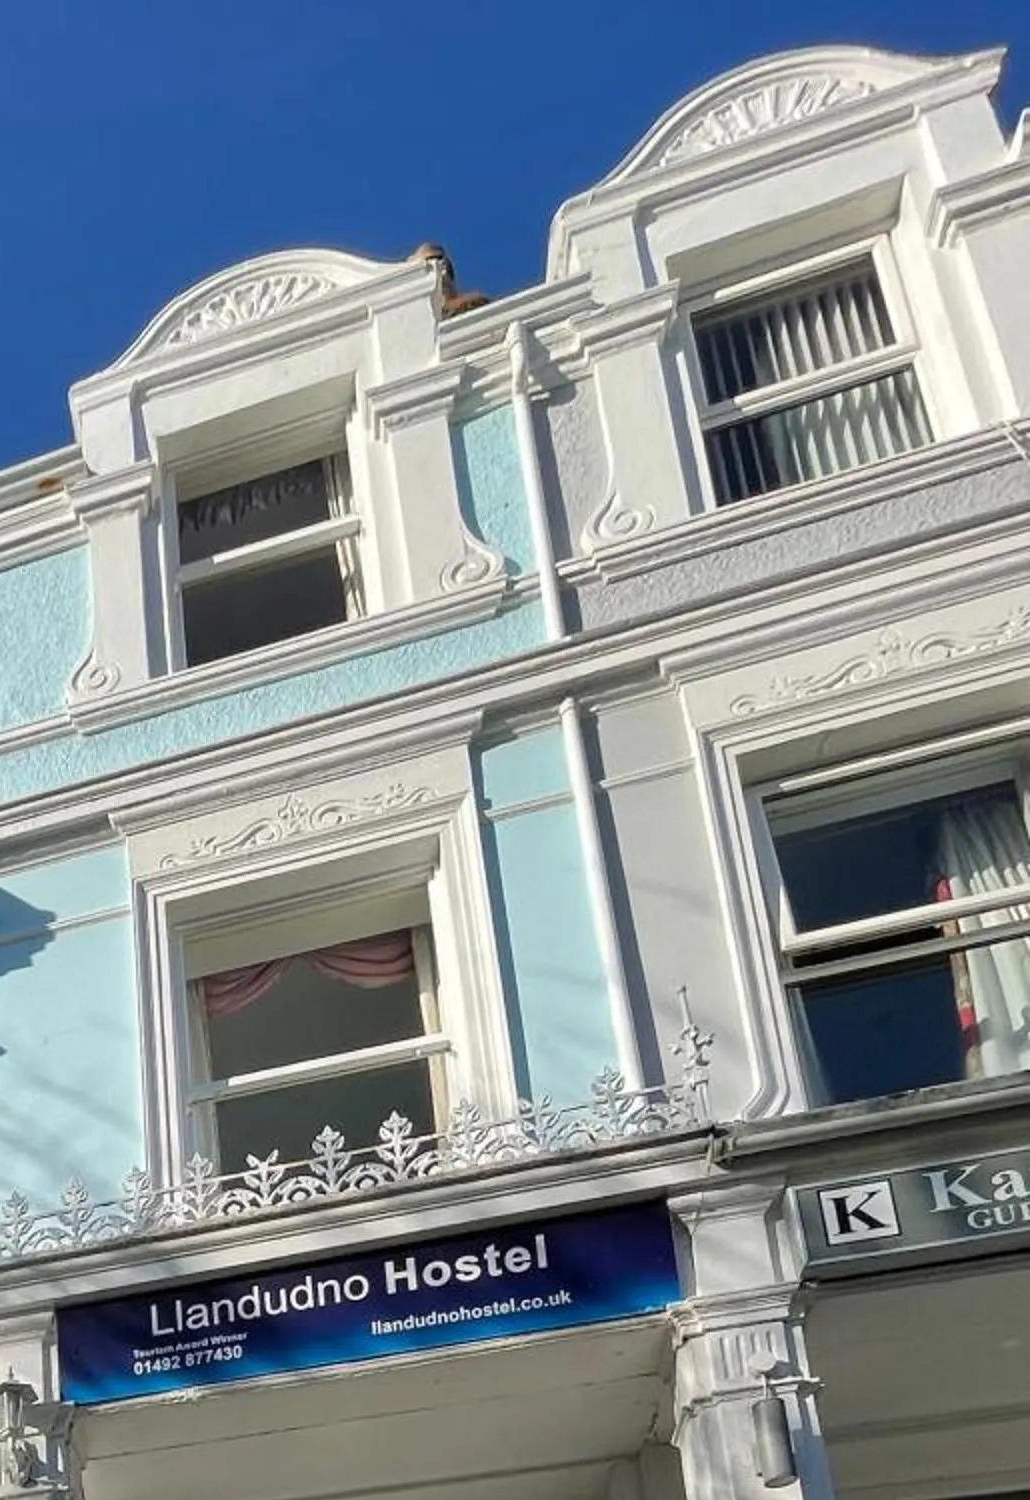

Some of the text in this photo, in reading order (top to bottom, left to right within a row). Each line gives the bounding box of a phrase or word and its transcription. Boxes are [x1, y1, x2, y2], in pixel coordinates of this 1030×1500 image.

[828, 1189, 888, 1236] K
[150, 1234, 549, 1337] Llandudno Hostel
[370, 1289, 572, 1335] llandudnohostel.co.uk
[132, 1332, 248, 1359] Tourism Award Winner
[133, 1344, 243, 1375] 01492 877430
